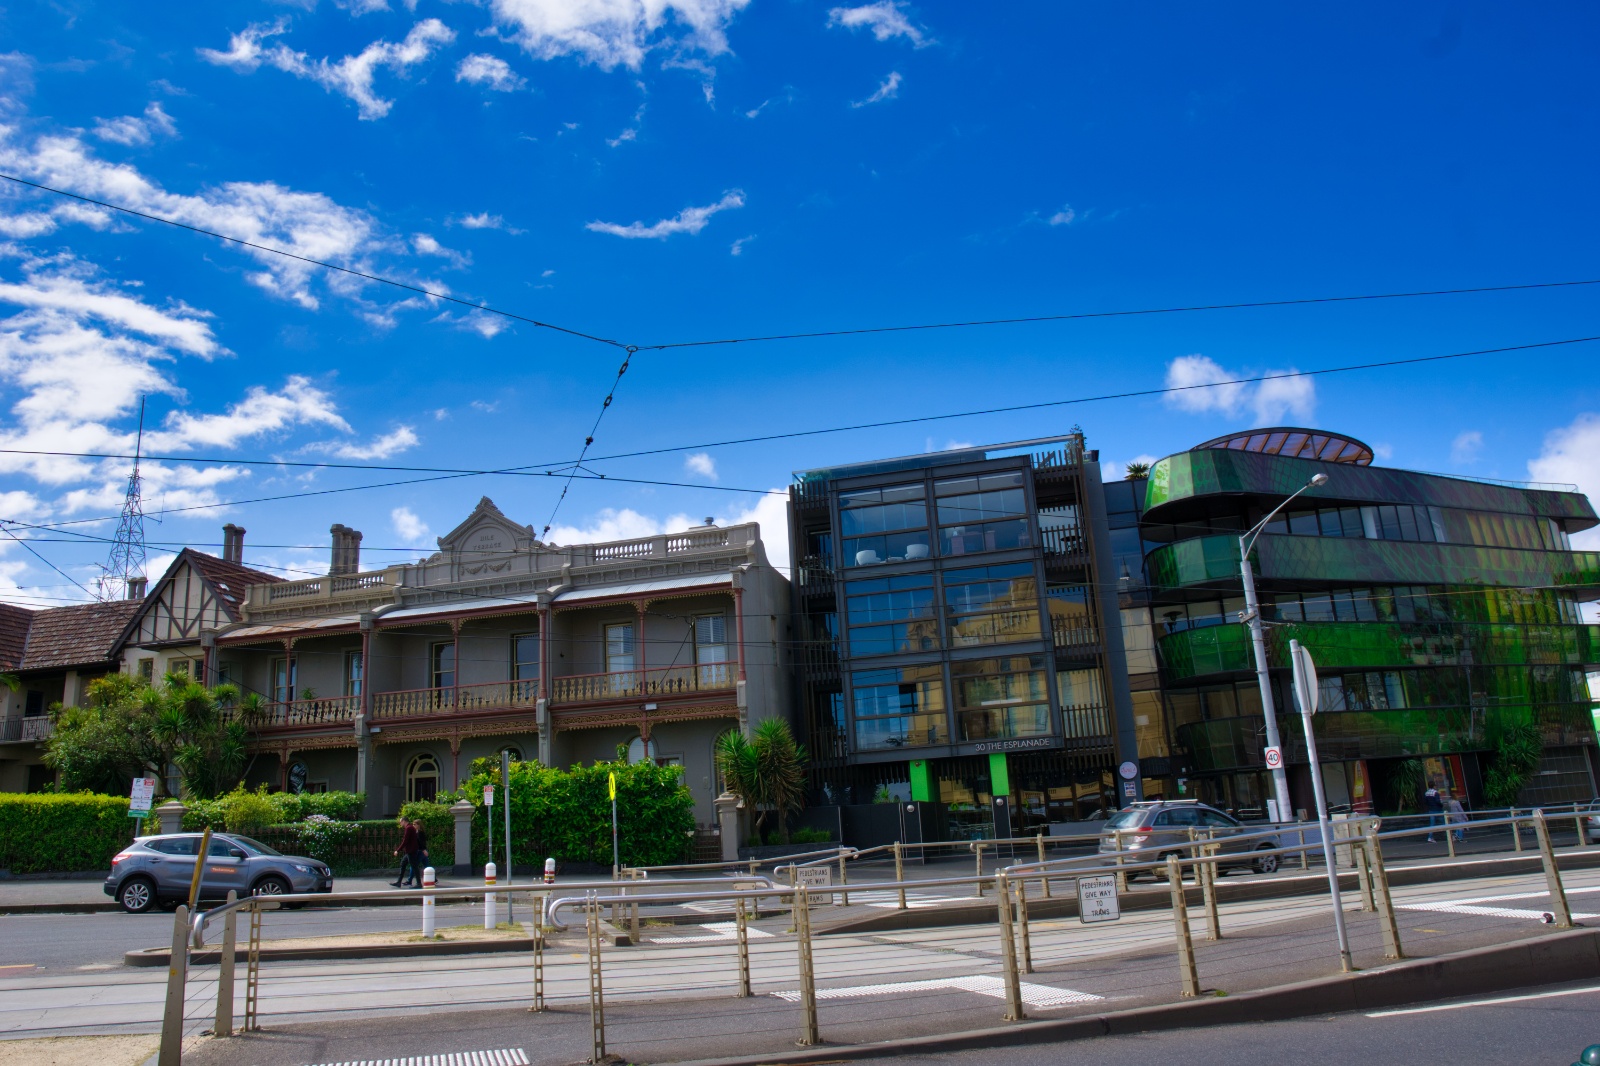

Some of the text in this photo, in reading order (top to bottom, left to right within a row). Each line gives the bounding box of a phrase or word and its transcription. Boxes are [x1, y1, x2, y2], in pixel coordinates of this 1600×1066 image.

[975, 738, 1050, 752] 30 THE ESPLANADE
[799, 869, 828, 877] PEDESTRIANS
[1081, 881, 1113, 889] PEDESTRIANS
[1099, 889, 1111, 897] WAY
[1091, 908, 1110, 916] TRAMS
